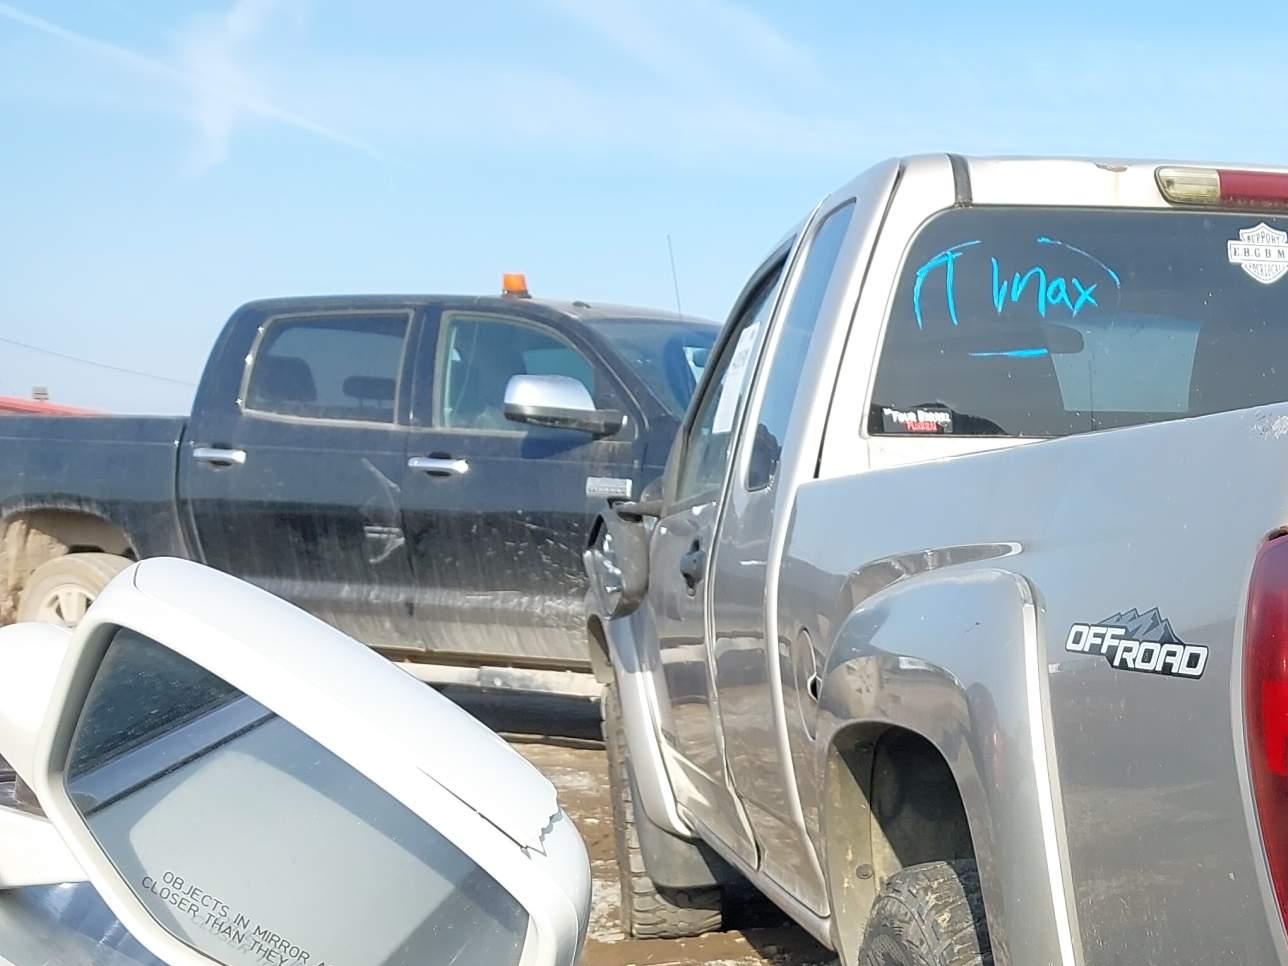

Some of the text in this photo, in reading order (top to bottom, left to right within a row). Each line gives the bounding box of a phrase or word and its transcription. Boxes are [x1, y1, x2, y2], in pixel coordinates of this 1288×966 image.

[1065, 623, 1126, 654] OFF
[1112, 640, 1209, 676] ROAD
[141, 876, 200, 918] CLOSER
[204, 912, 246, 945] THAN
[249, 939, 289, 966] THEY
[162, 871, 230, 918] OBJECTS
[233, 912, 250, 930] IN
[252, 925, 311, 964] MIRROR
